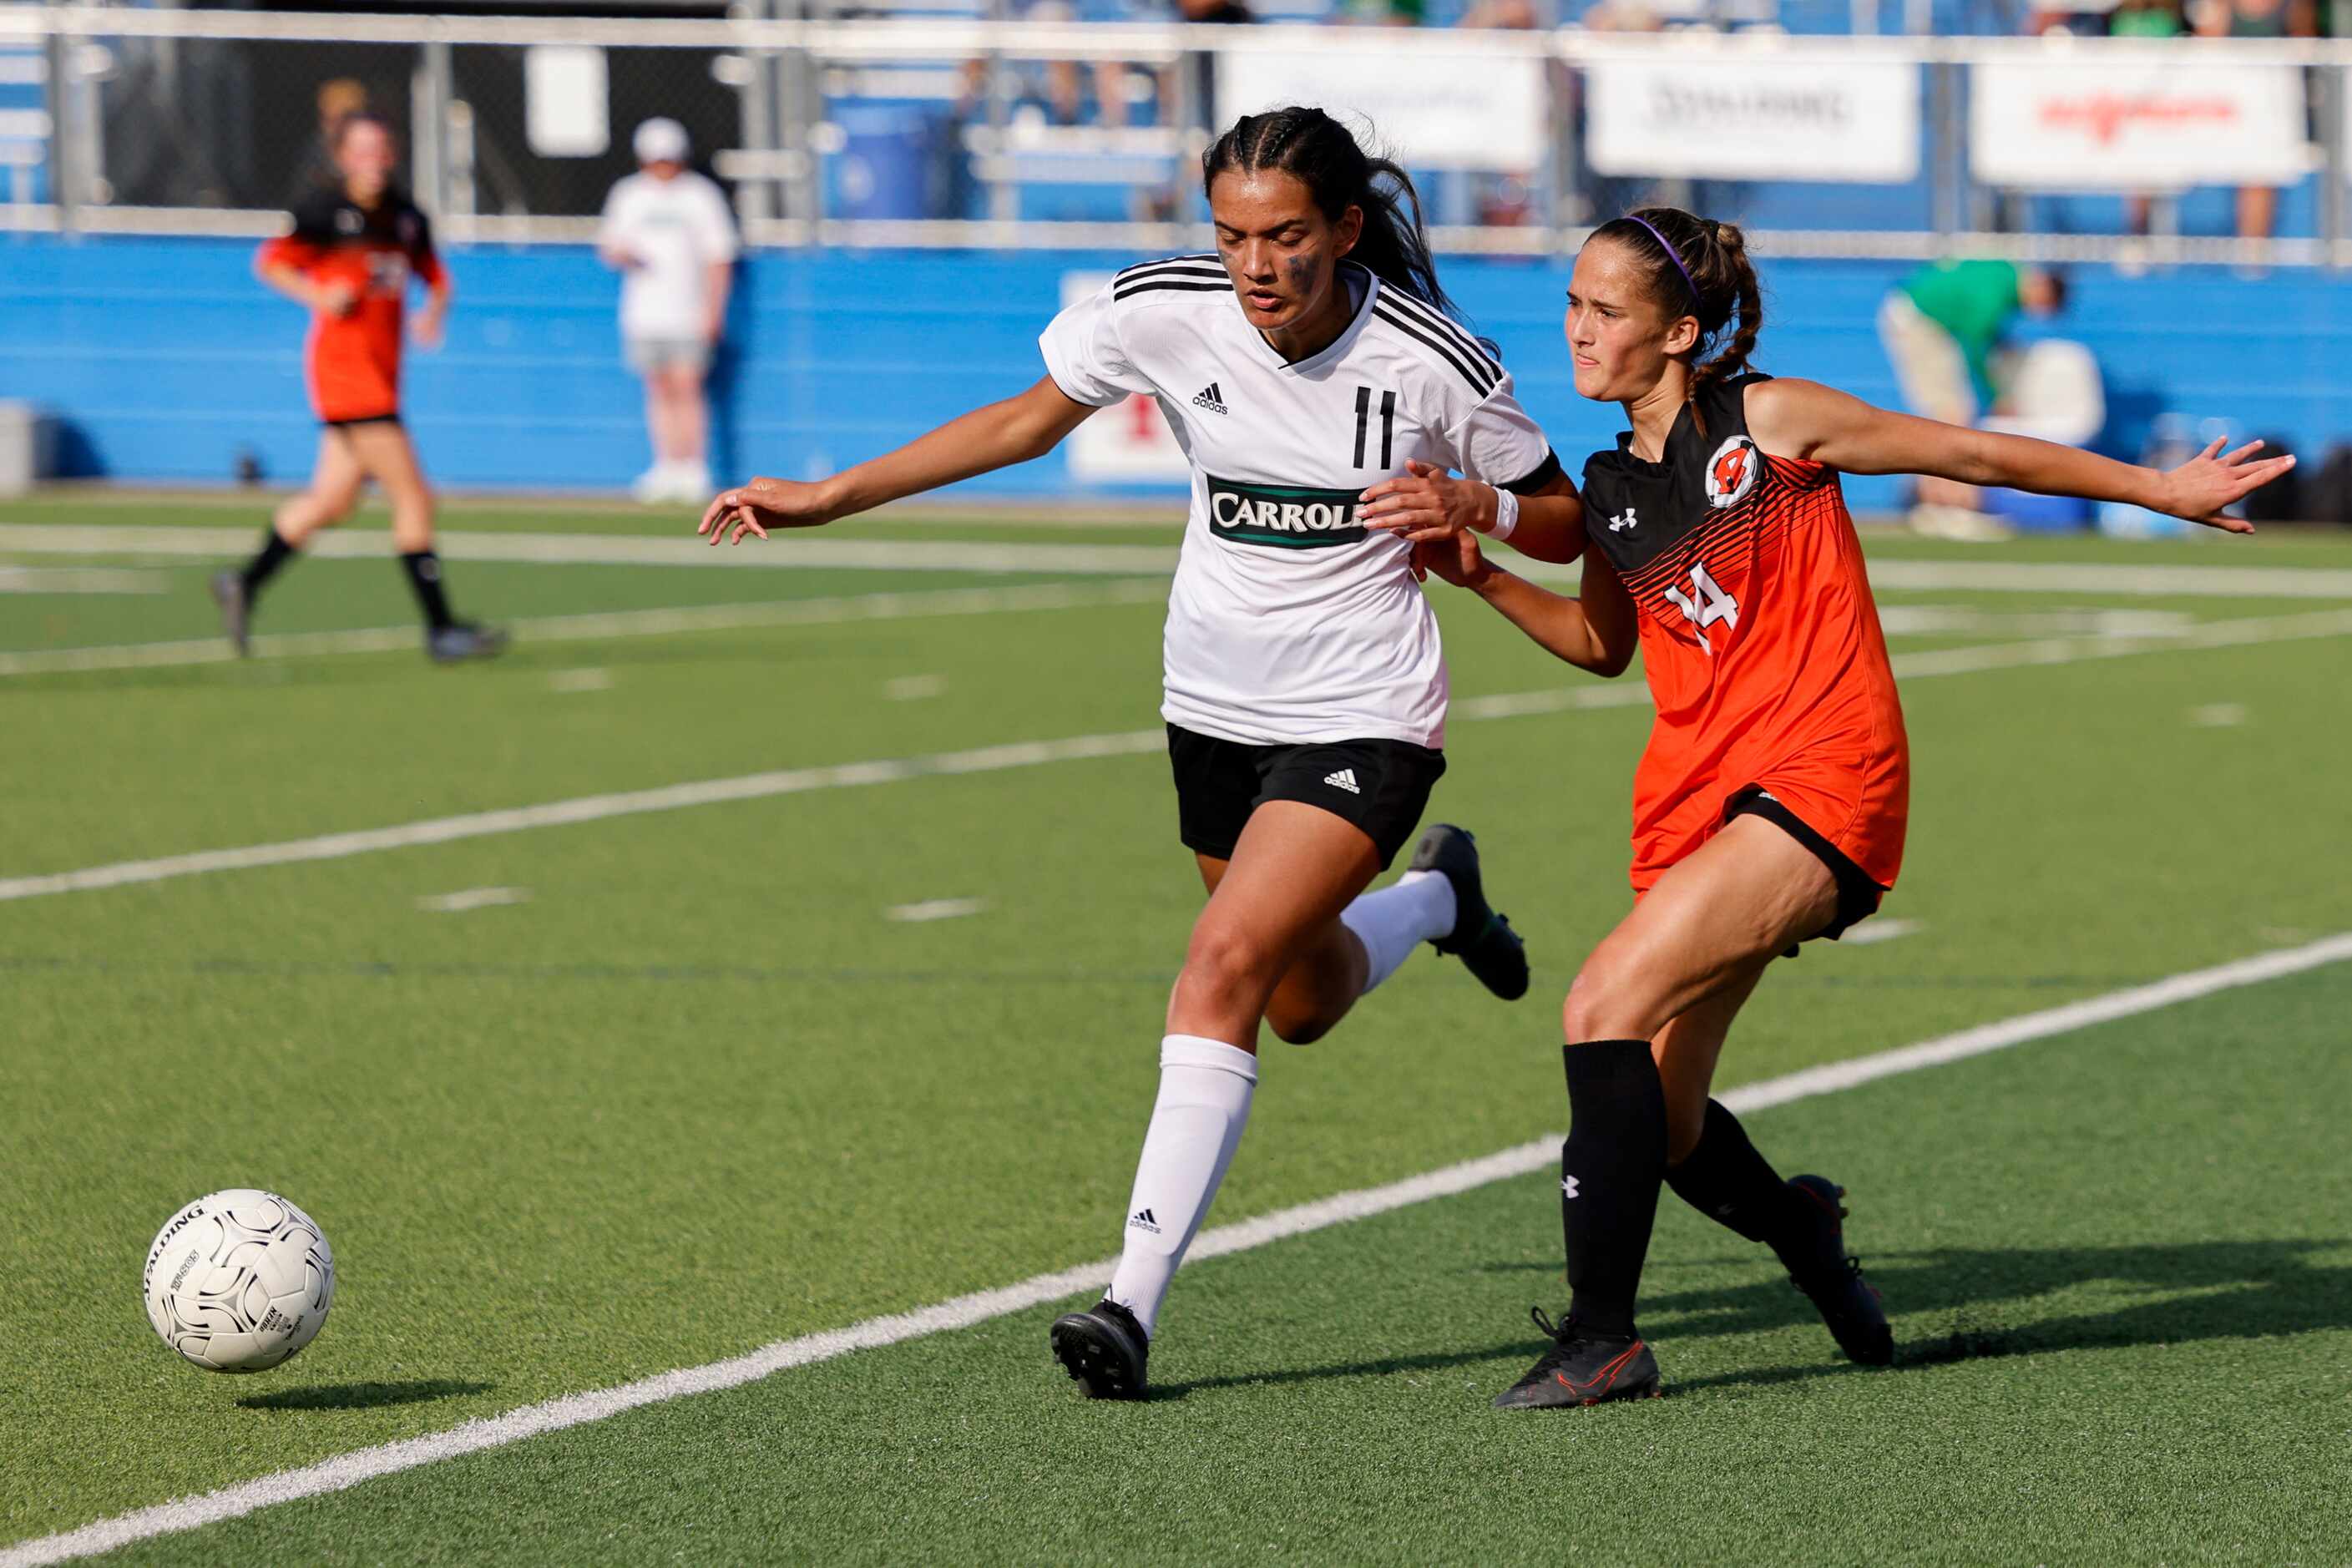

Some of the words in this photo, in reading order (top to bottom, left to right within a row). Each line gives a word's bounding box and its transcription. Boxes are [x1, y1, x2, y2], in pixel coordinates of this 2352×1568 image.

[1192, 396, 1229, 416] adidas
[1353, 386, 1396, 470] 11
[1663, 561, 1740, 656] 14
